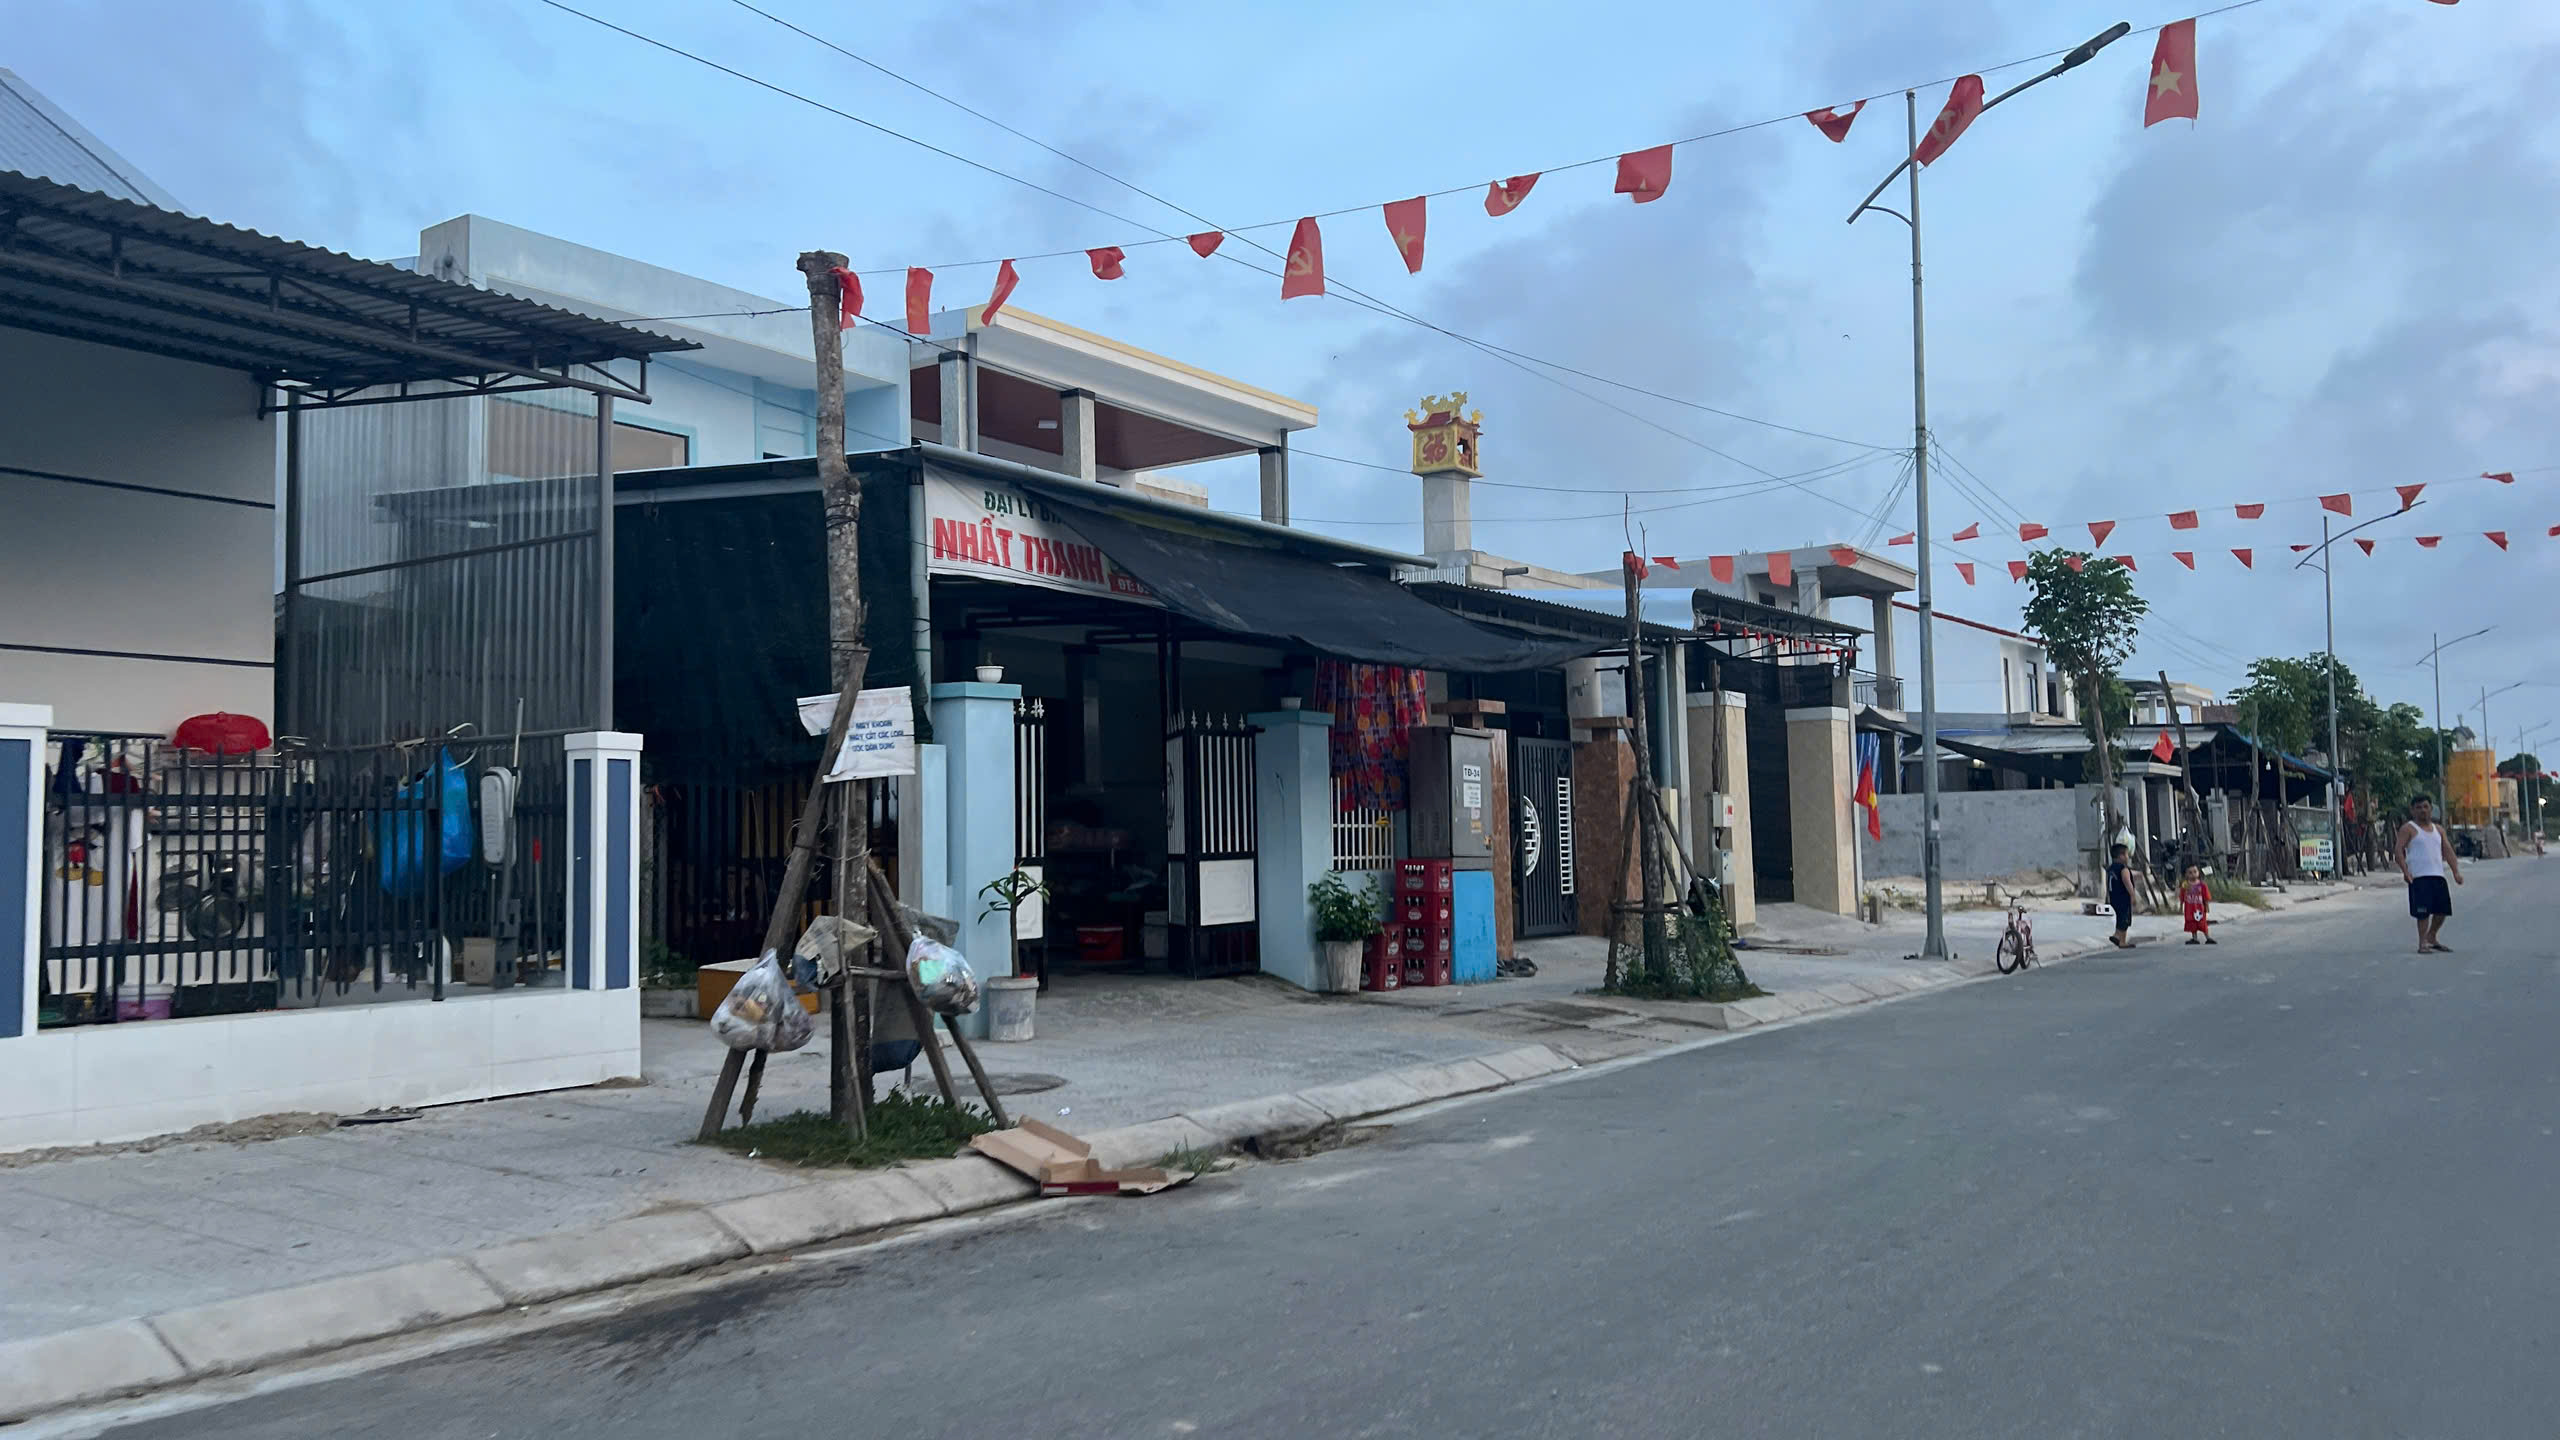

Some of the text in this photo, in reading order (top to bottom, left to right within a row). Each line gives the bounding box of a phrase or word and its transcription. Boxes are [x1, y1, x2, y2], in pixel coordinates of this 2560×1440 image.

[984, 490, 1013, 517] ĐẠI
[1019, 533, 1105, 585] THANH
[1464, 768, 1480, 778] TĐ-34
